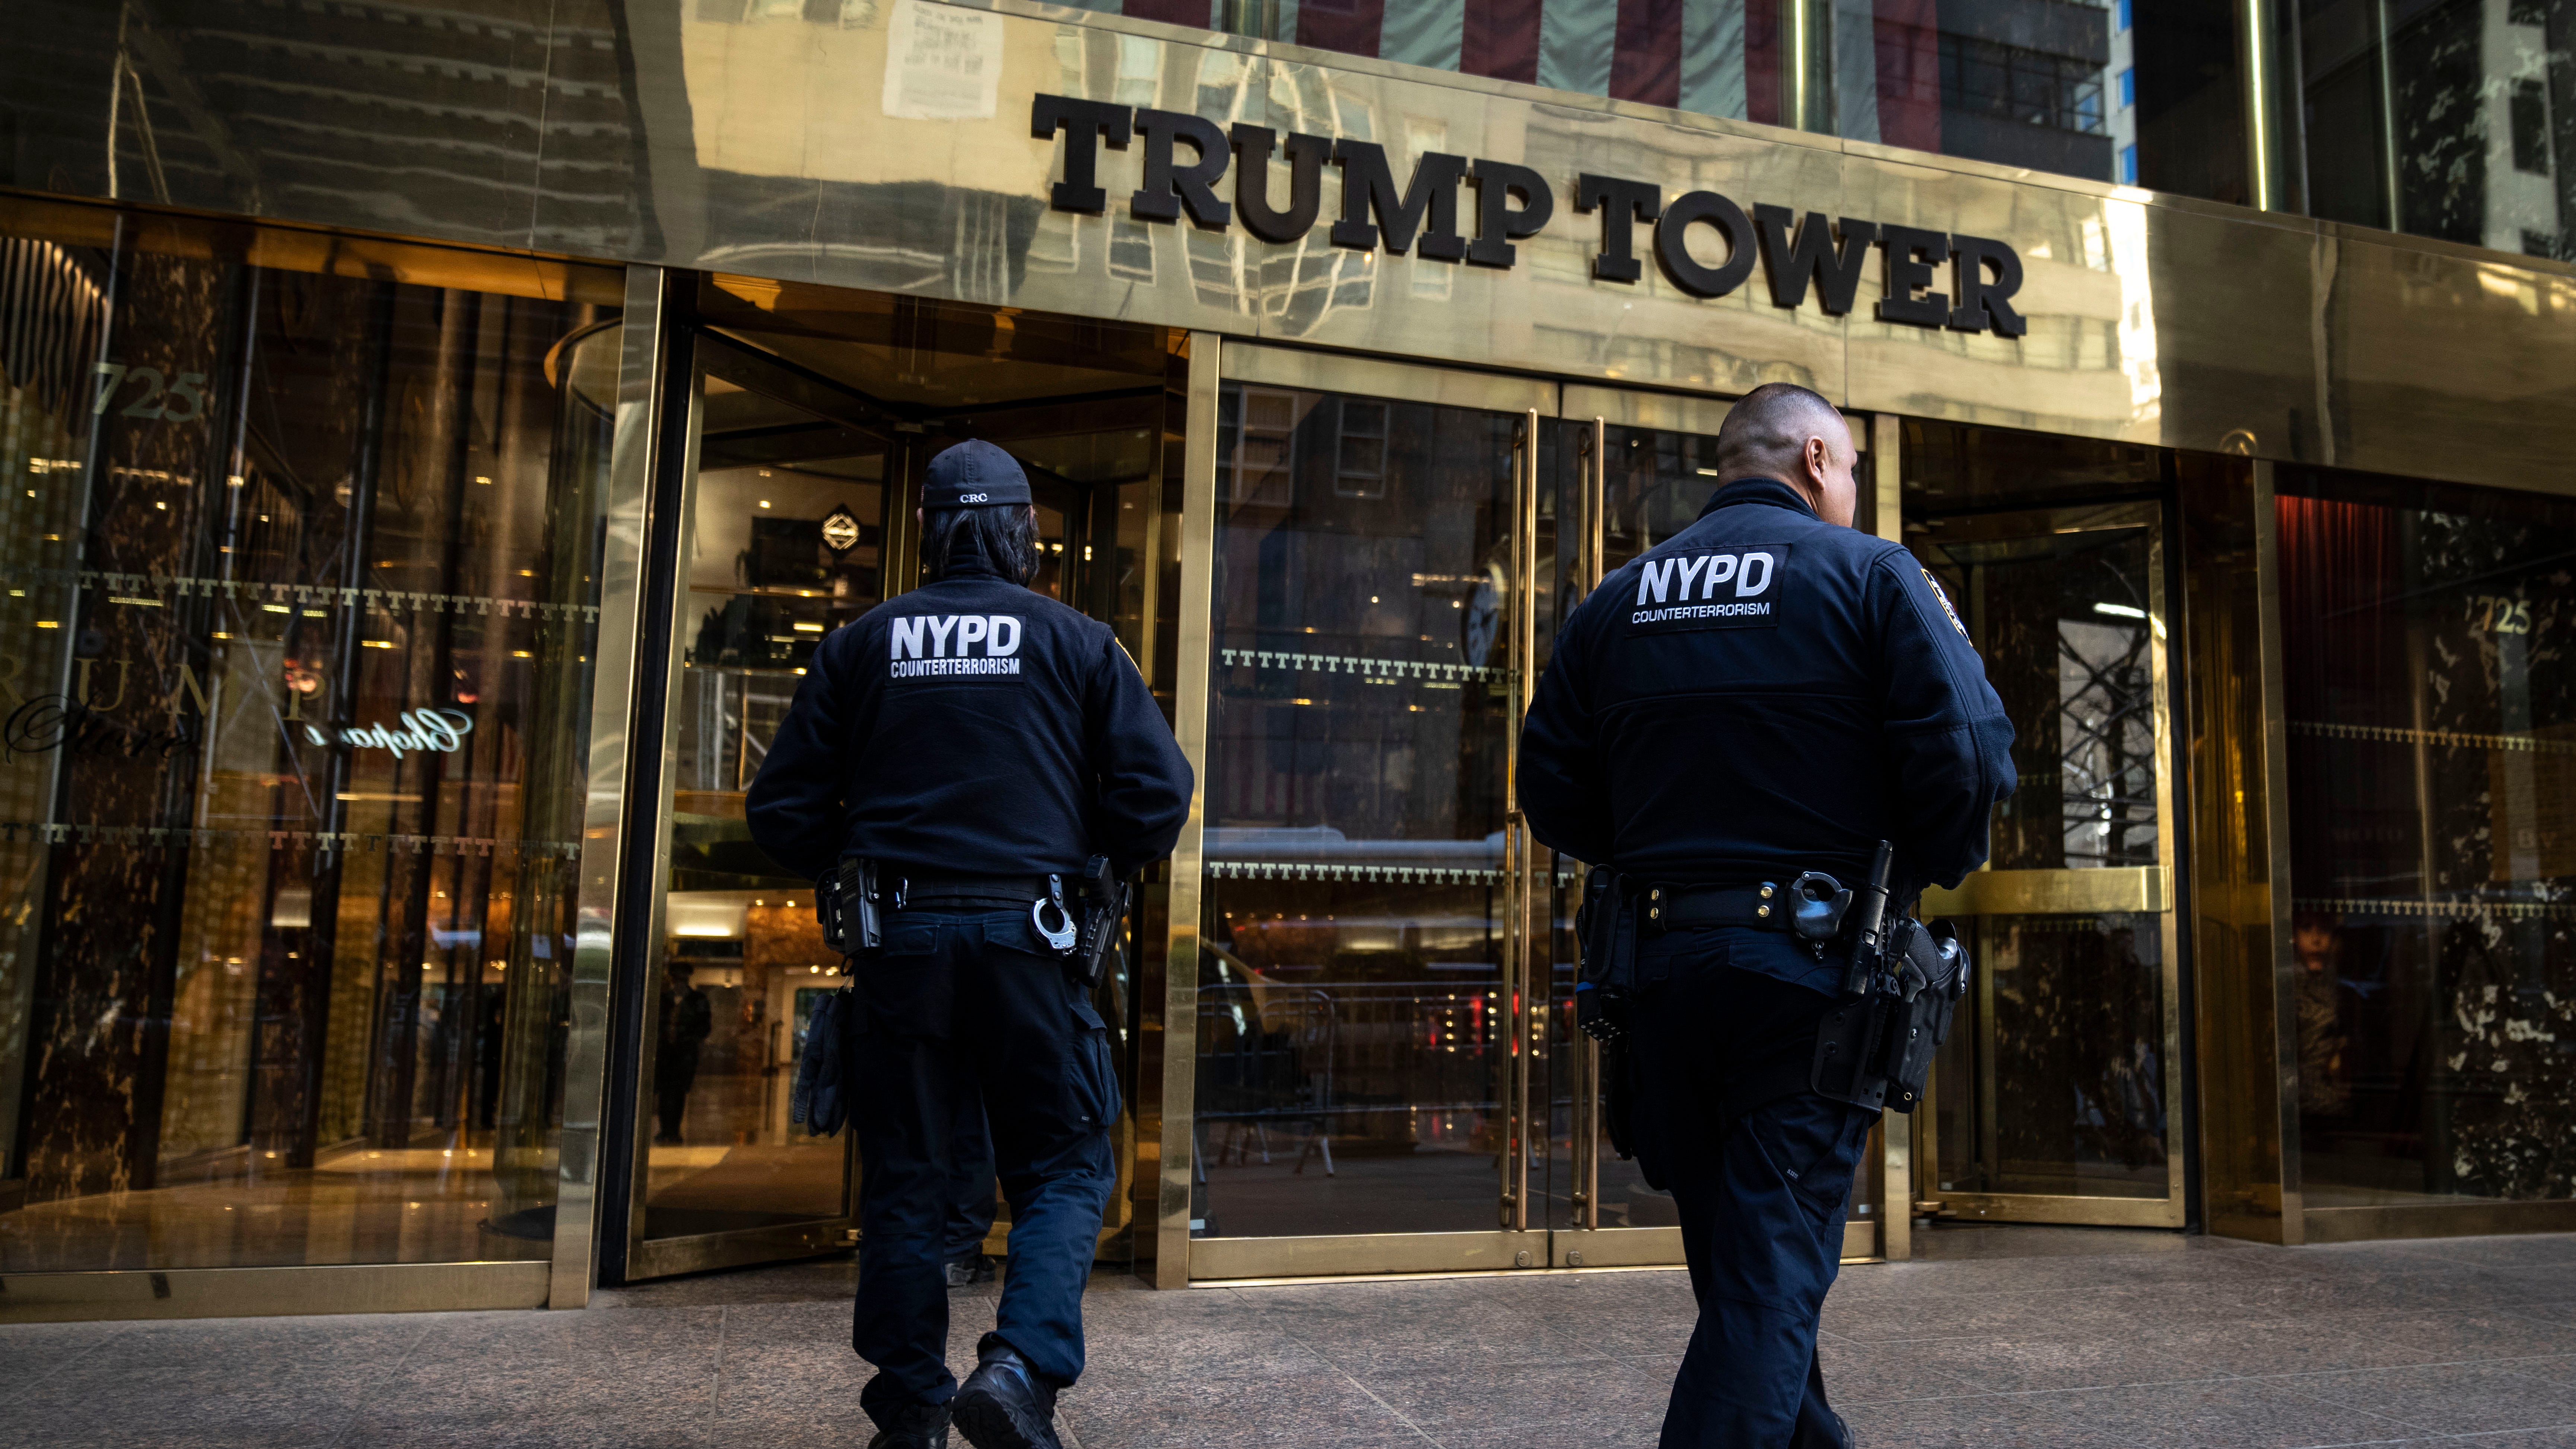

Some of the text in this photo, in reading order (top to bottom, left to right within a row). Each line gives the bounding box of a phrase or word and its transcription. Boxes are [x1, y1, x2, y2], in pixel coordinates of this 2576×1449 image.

[1031, 93, 2026, 340] TRUMP TOWER
[90, 362, 207, 422] 725
[960, 493, 988, 503] CRC
[1637, 552, 1774, 606] NYPD
[1632, 602, 1769, 624] COUNTERTERRORISM
[2477, 596, 2531, 635] 725
[891, 615, 1021, 660] NYPD
[890, 658, 1020, 678] COUNTERTERRORISM
